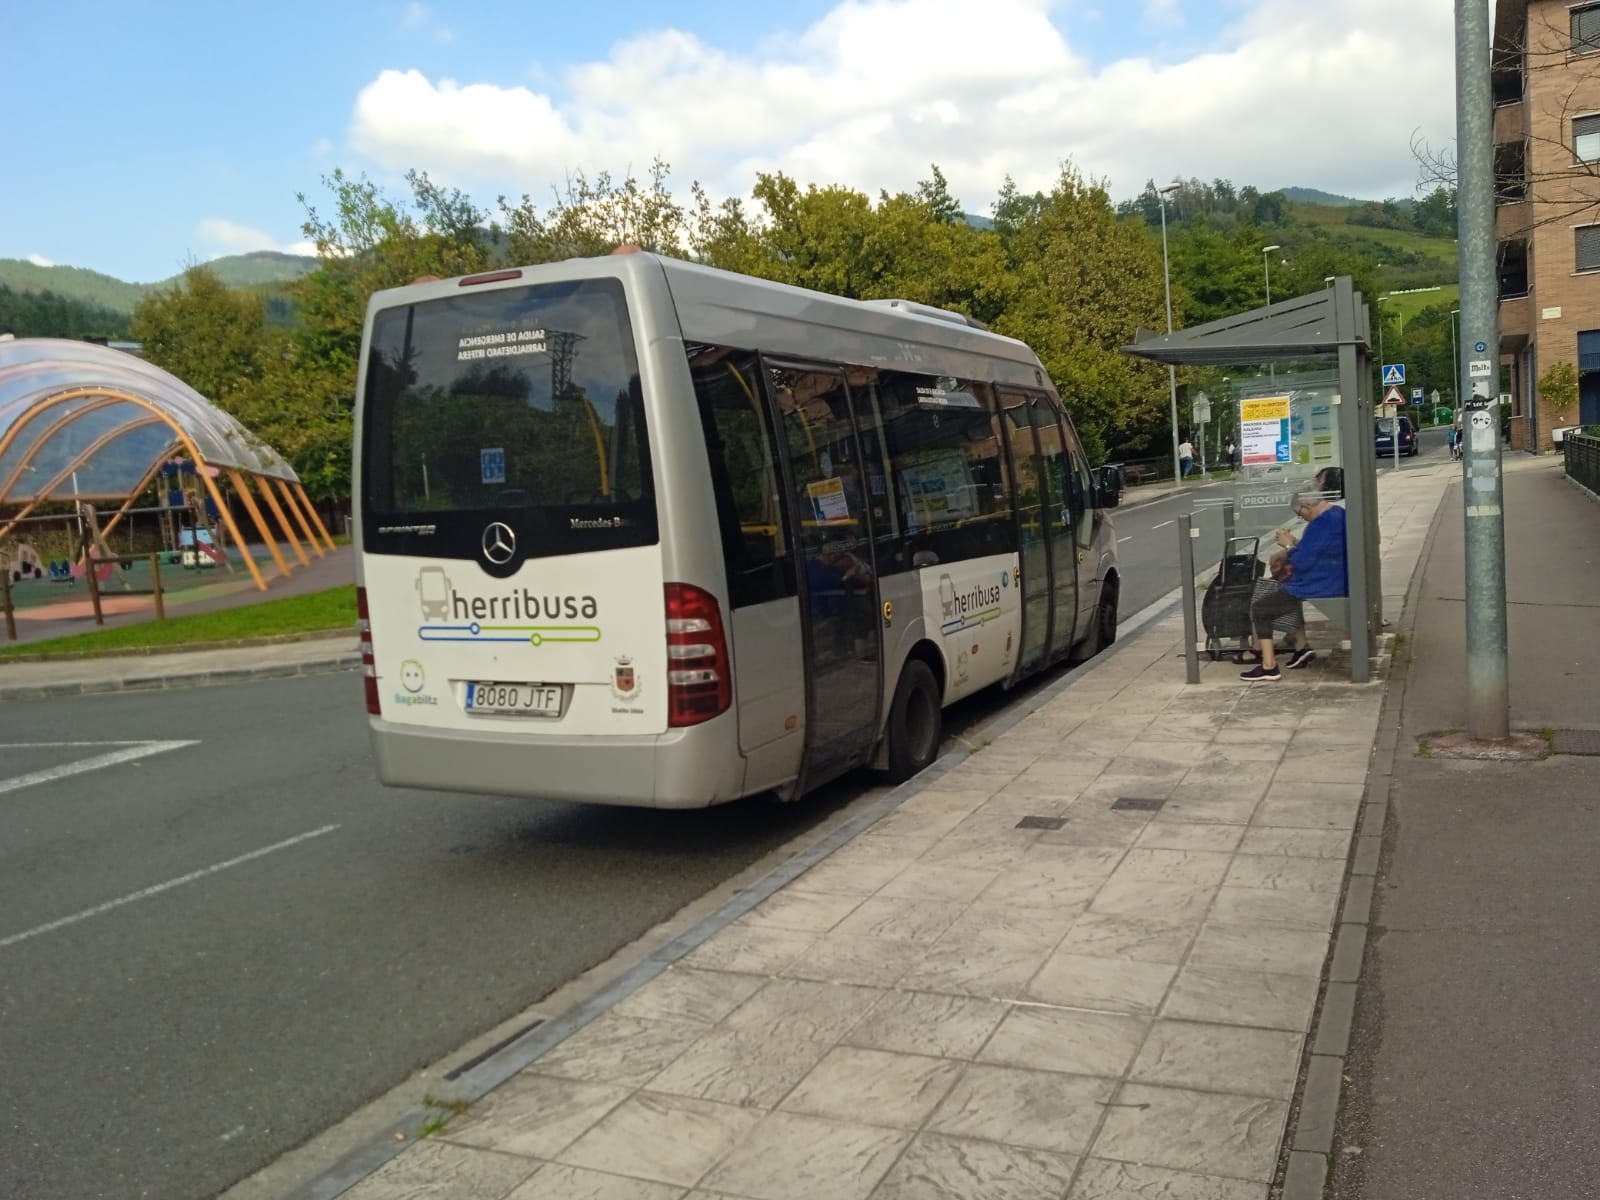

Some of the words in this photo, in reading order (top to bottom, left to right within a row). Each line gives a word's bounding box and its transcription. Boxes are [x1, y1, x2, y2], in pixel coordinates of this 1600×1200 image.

[570, 517, 612, 529] Mercedes
[452, 588, 598, 620] herribusa
[954, 584, 1000, 615] herribusa
[476, 687, 518, 707] 8080
[524, 688, 557, 709] JTF
